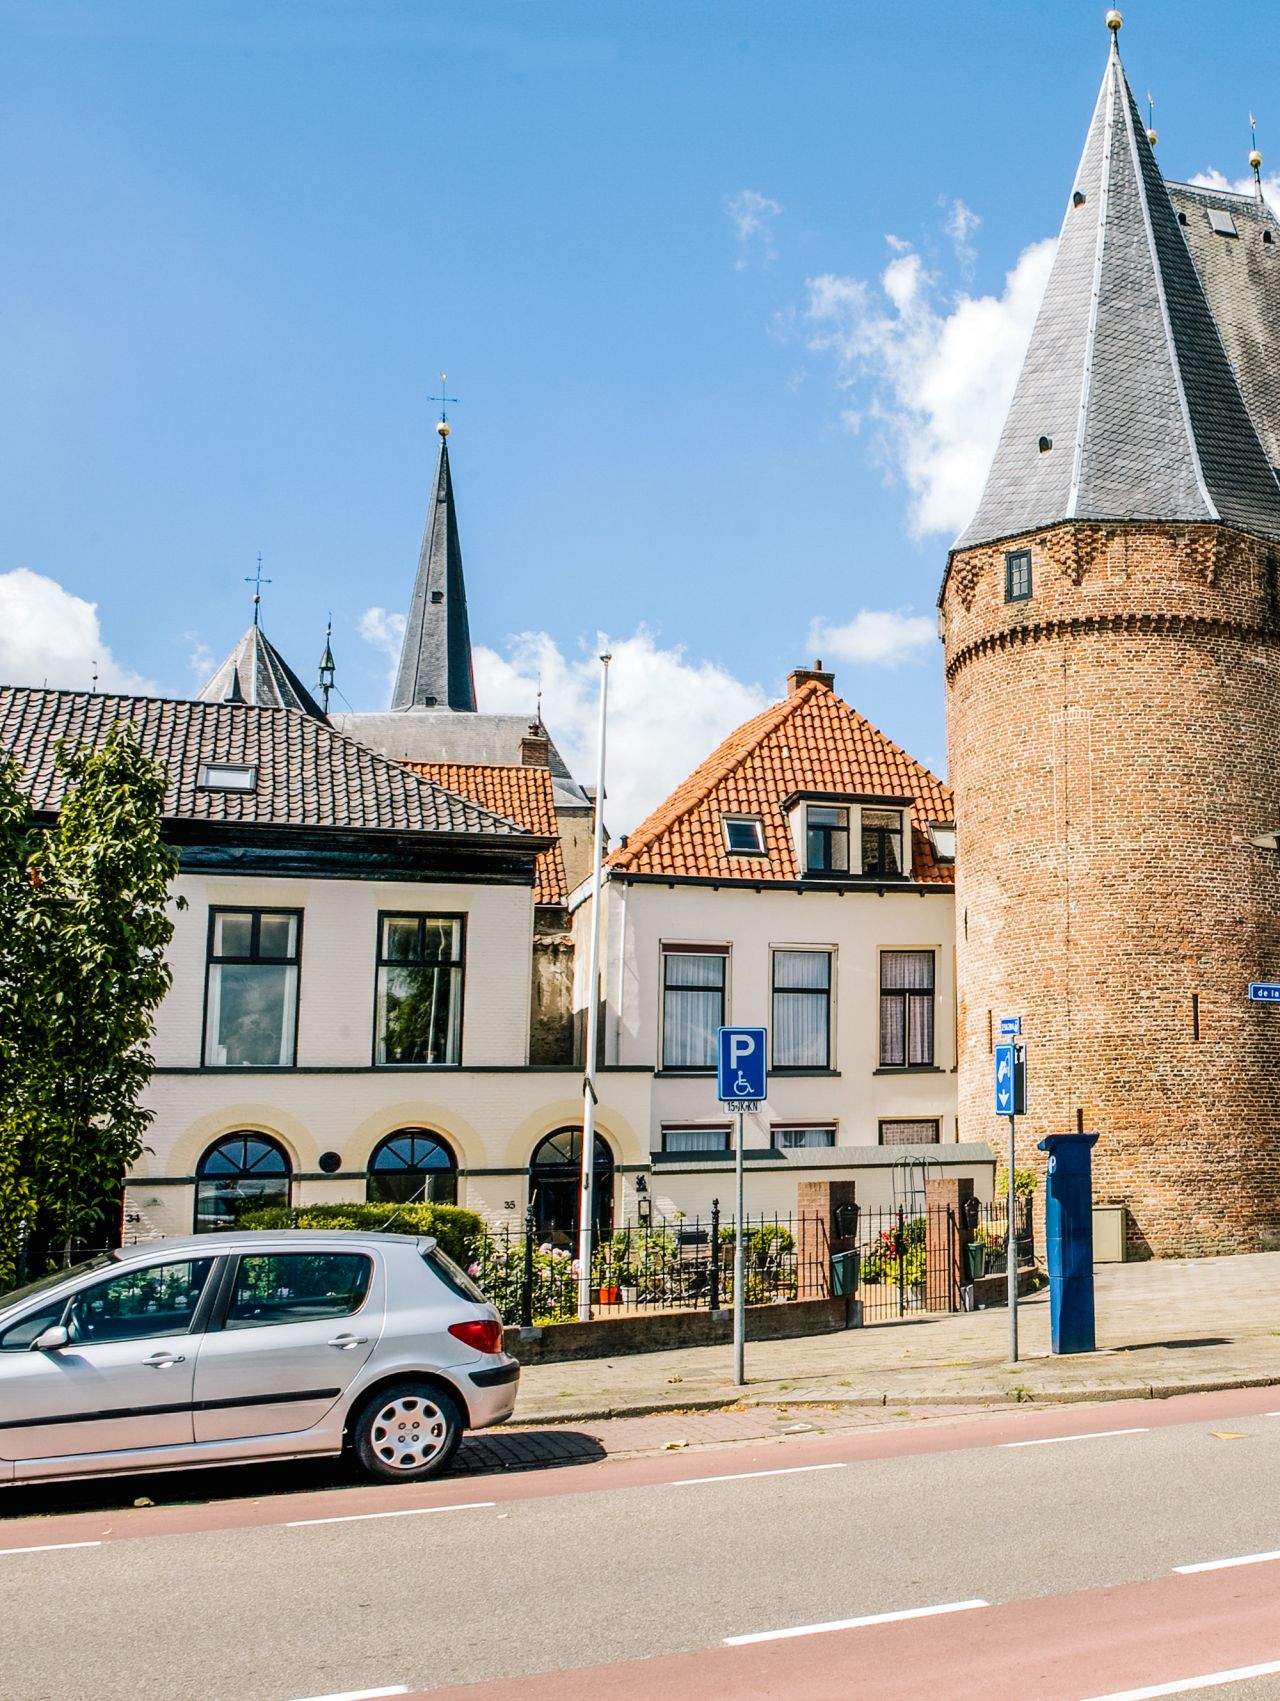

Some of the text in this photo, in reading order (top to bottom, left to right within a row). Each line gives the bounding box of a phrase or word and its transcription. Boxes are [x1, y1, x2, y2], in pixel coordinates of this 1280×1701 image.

[1258, 989, 1268, 997] de
[730, 1034, 755, 1069] P
[504, 1200, 516, 1209] 35
